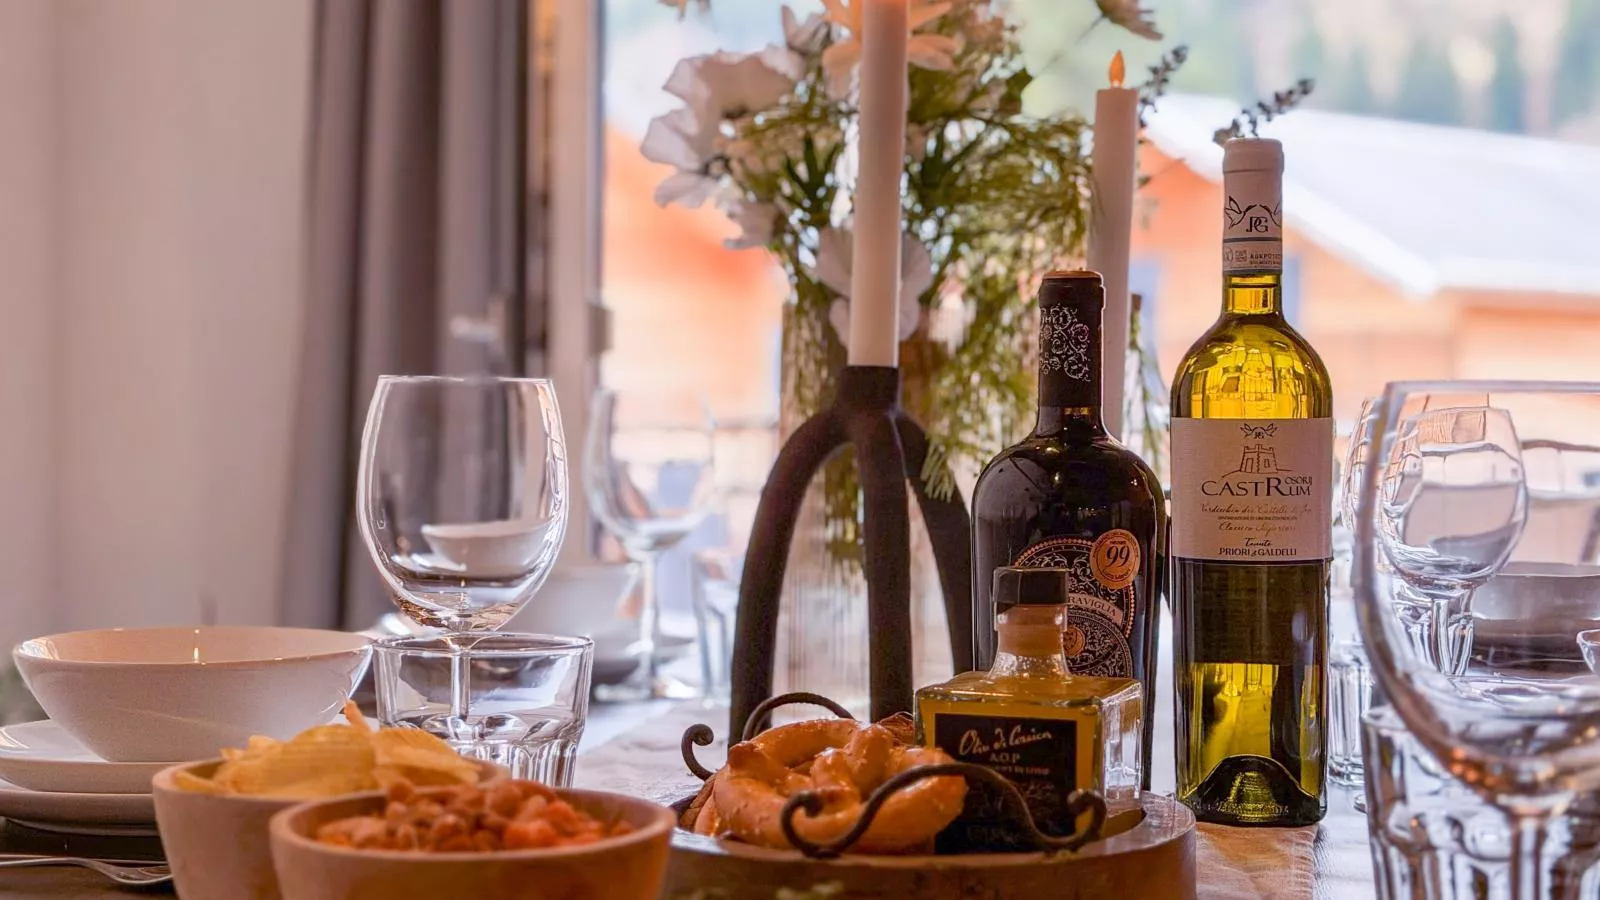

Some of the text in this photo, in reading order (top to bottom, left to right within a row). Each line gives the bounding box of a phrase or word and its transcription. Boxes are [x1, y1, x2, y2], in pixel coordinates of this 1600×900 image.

[1106, 545, 1130, 568] 99
[1219, 548, 1250, 556] PRIORI
[1257, 548, 1297, 557] GALDELLI
[1068, 597, 1116, 616] RAVIGLIA
